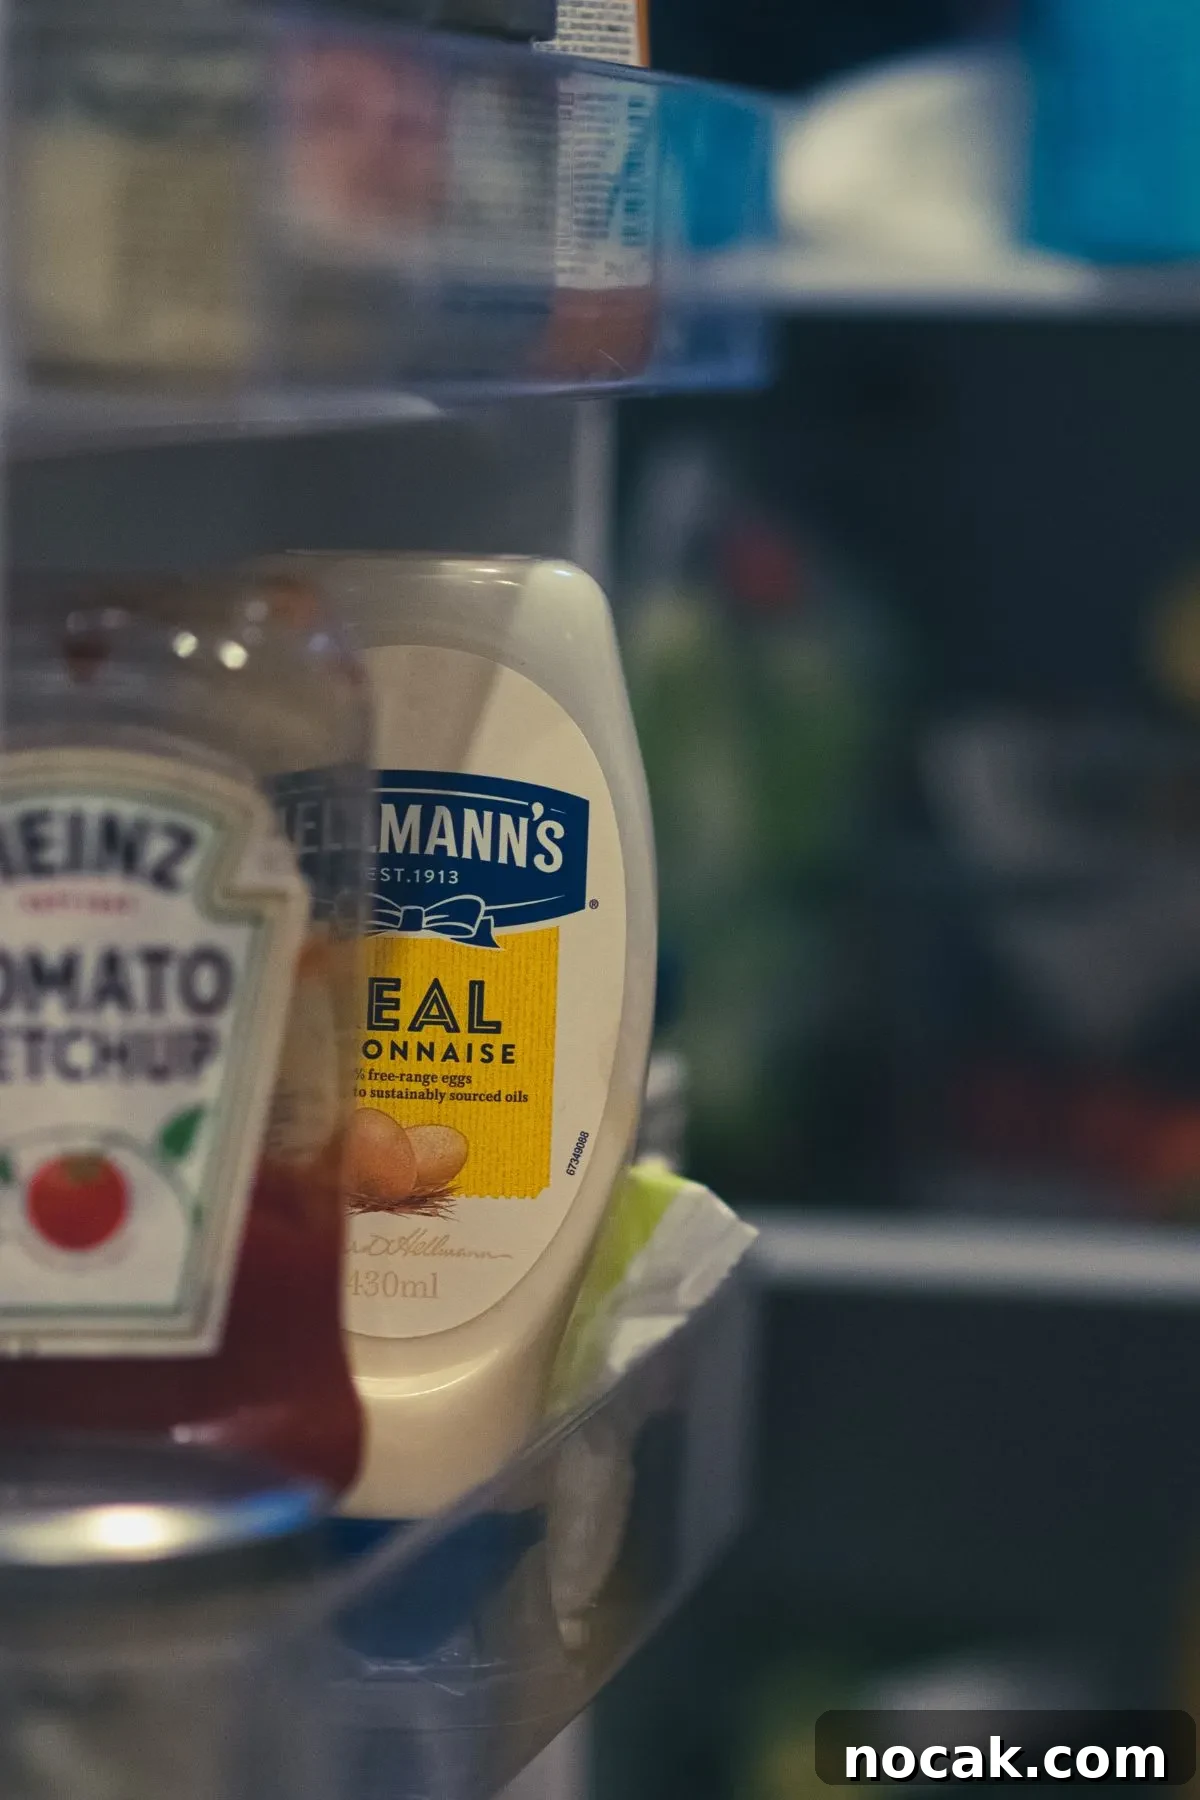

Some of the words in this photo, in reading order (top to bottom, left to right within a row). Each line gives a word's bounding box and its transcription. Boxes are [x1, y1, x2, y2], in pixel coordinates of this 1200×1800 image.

[0, 806, 200, 892] EINZ
[280, 800, 566, 873] ELLMANN'S
[366, 977, 502, 1034] EAL
[361, 1039, 516, 1064] ONNAISE
[368, 1068, 438, 1087] free-range
[441, 1073, 472, 1088] eggs
[369, 1088, 446, 1105] sustainably
[449, 1090, 502, 1103] sourced
[504, 1091, 529, 1103] oils
[566, 1130, 589, 1176] 67349088
[345, 1270, 439, 1299] 430ml
